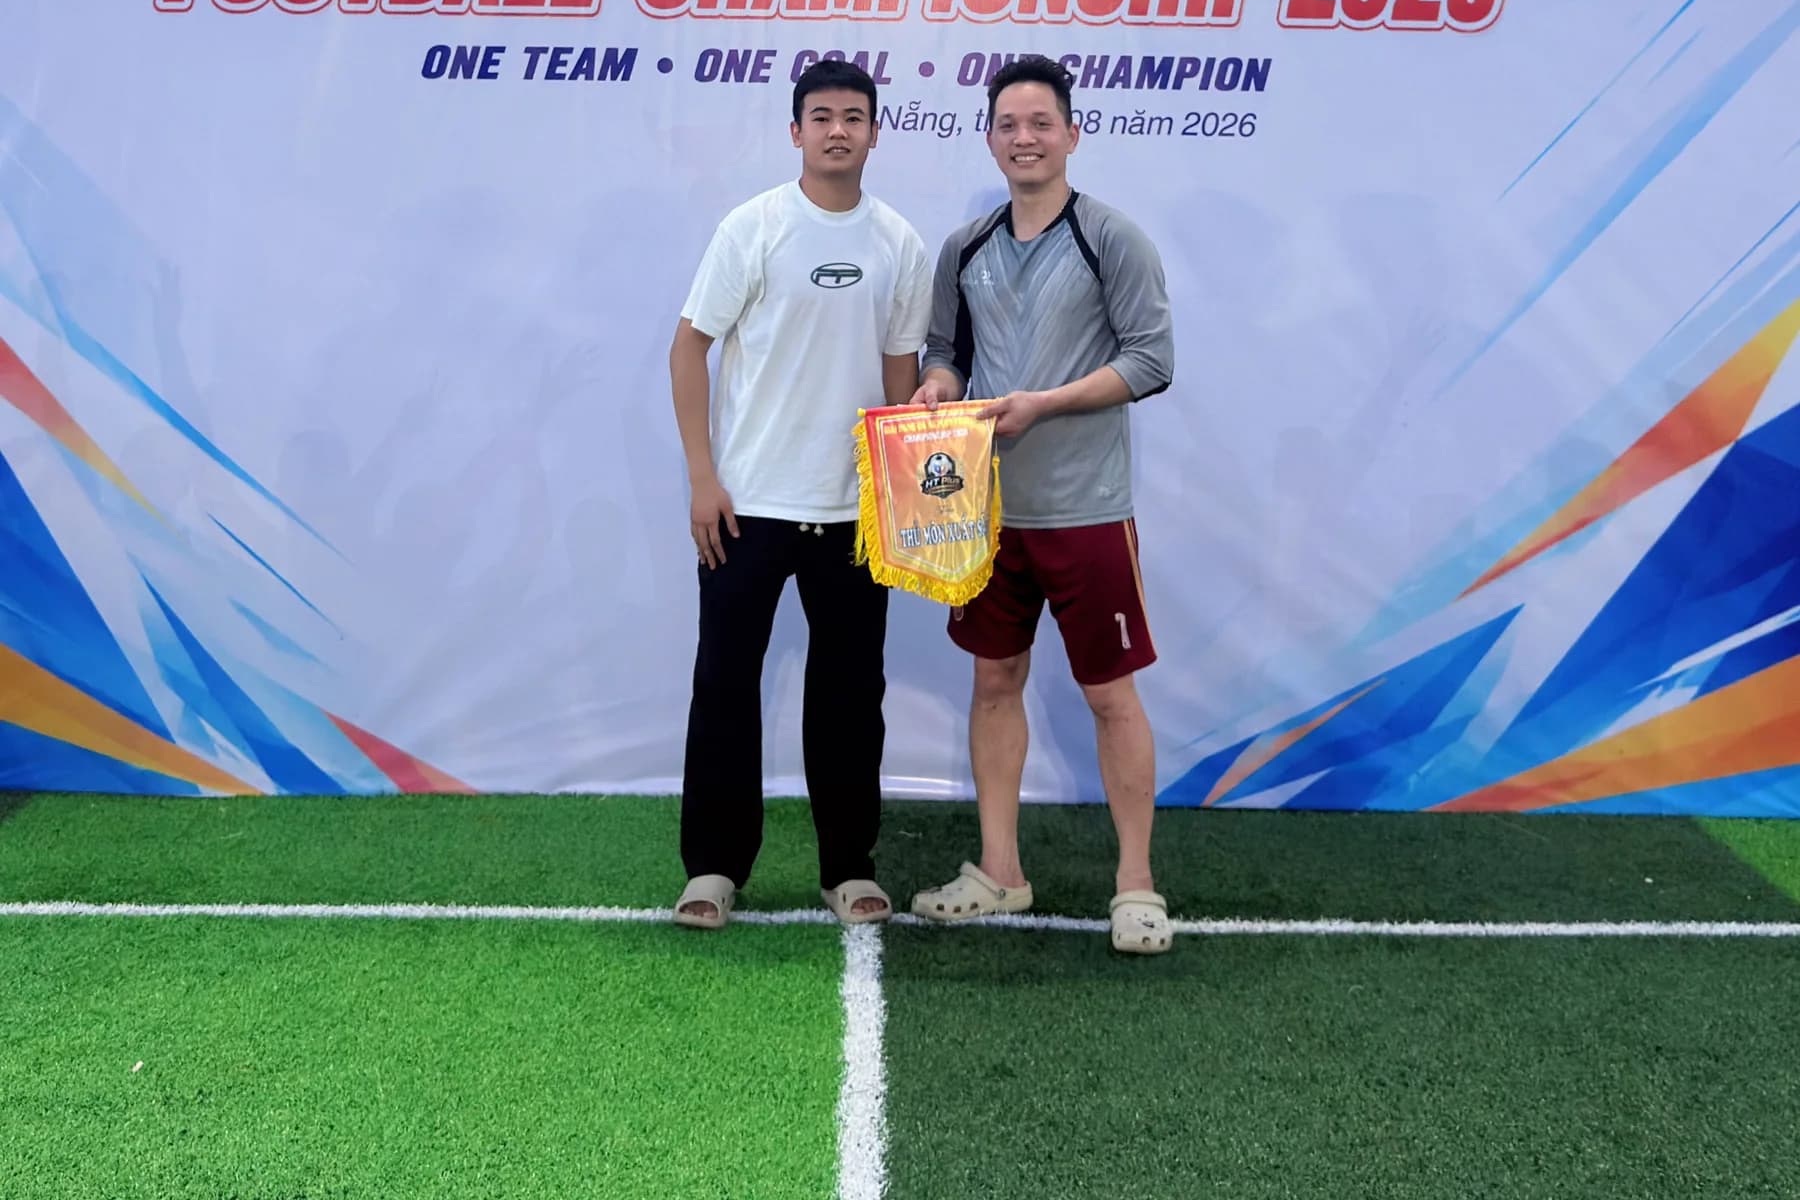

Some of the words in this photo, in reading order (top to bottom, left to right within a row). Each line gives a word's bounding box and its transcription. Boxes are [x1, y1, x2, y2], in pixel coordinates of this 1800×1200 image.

[421, 44, 507, 80] ONE
[522, 46, 639, 81] TEAM
[694, 48, 777, 83] ONE
[879, 100, 962, 138] Nẵng,
[1109, 109, 1174, 135] năm
[1181, 112, 1257, 137] 2026
[1114, 612, 1132, 650] 1
